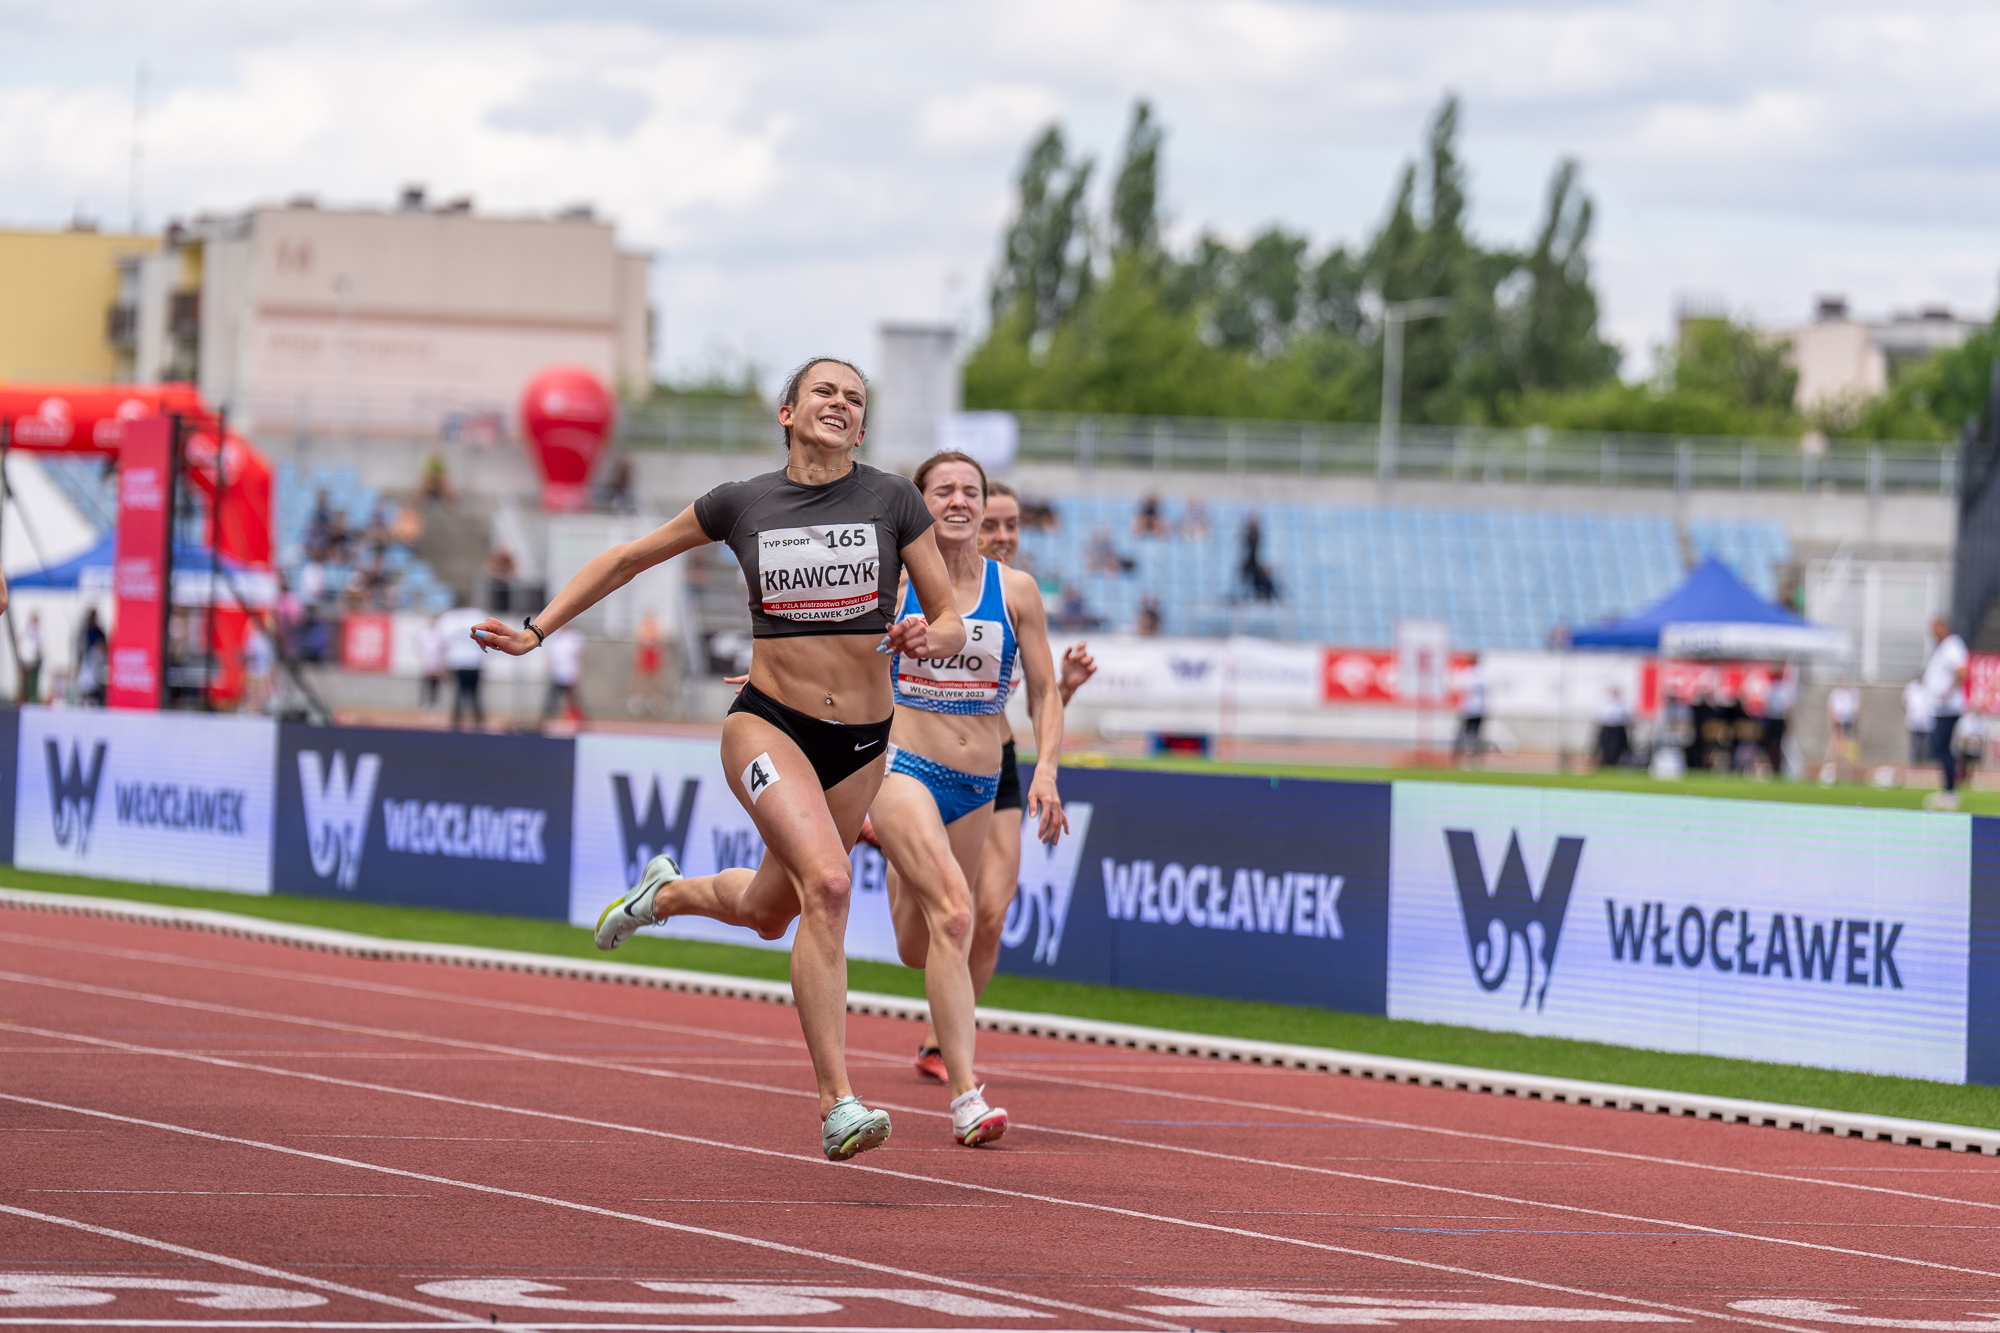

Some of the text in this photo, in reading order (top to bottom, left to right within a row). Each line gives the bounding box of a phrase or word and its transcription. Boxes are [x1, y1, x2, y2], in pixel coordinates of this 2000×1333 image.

[782, 538, 810, 547] SPORT
[825, 529, 866, 548] 165
[765, 562, 875, 591] KRAWCZYK
[800, 600, 840, 608] Mistrzostwa
[841, 598, 860, 606] Polski
[861, 594, 873, 602] U23
[844, 605, 866, 616] 2023
[971, 626, 983, 641] 5
[751, 761, 770, 792] 4
[115, 780, 246, 834] WŁOCŁAWEK
[384, 799, 546, 864] WŁOCŁAWEK
[1101, 857, 1345, 940] WŁOCŁAWEK
[1606, 898, 1904, 990] WŁOCŁAWEK
